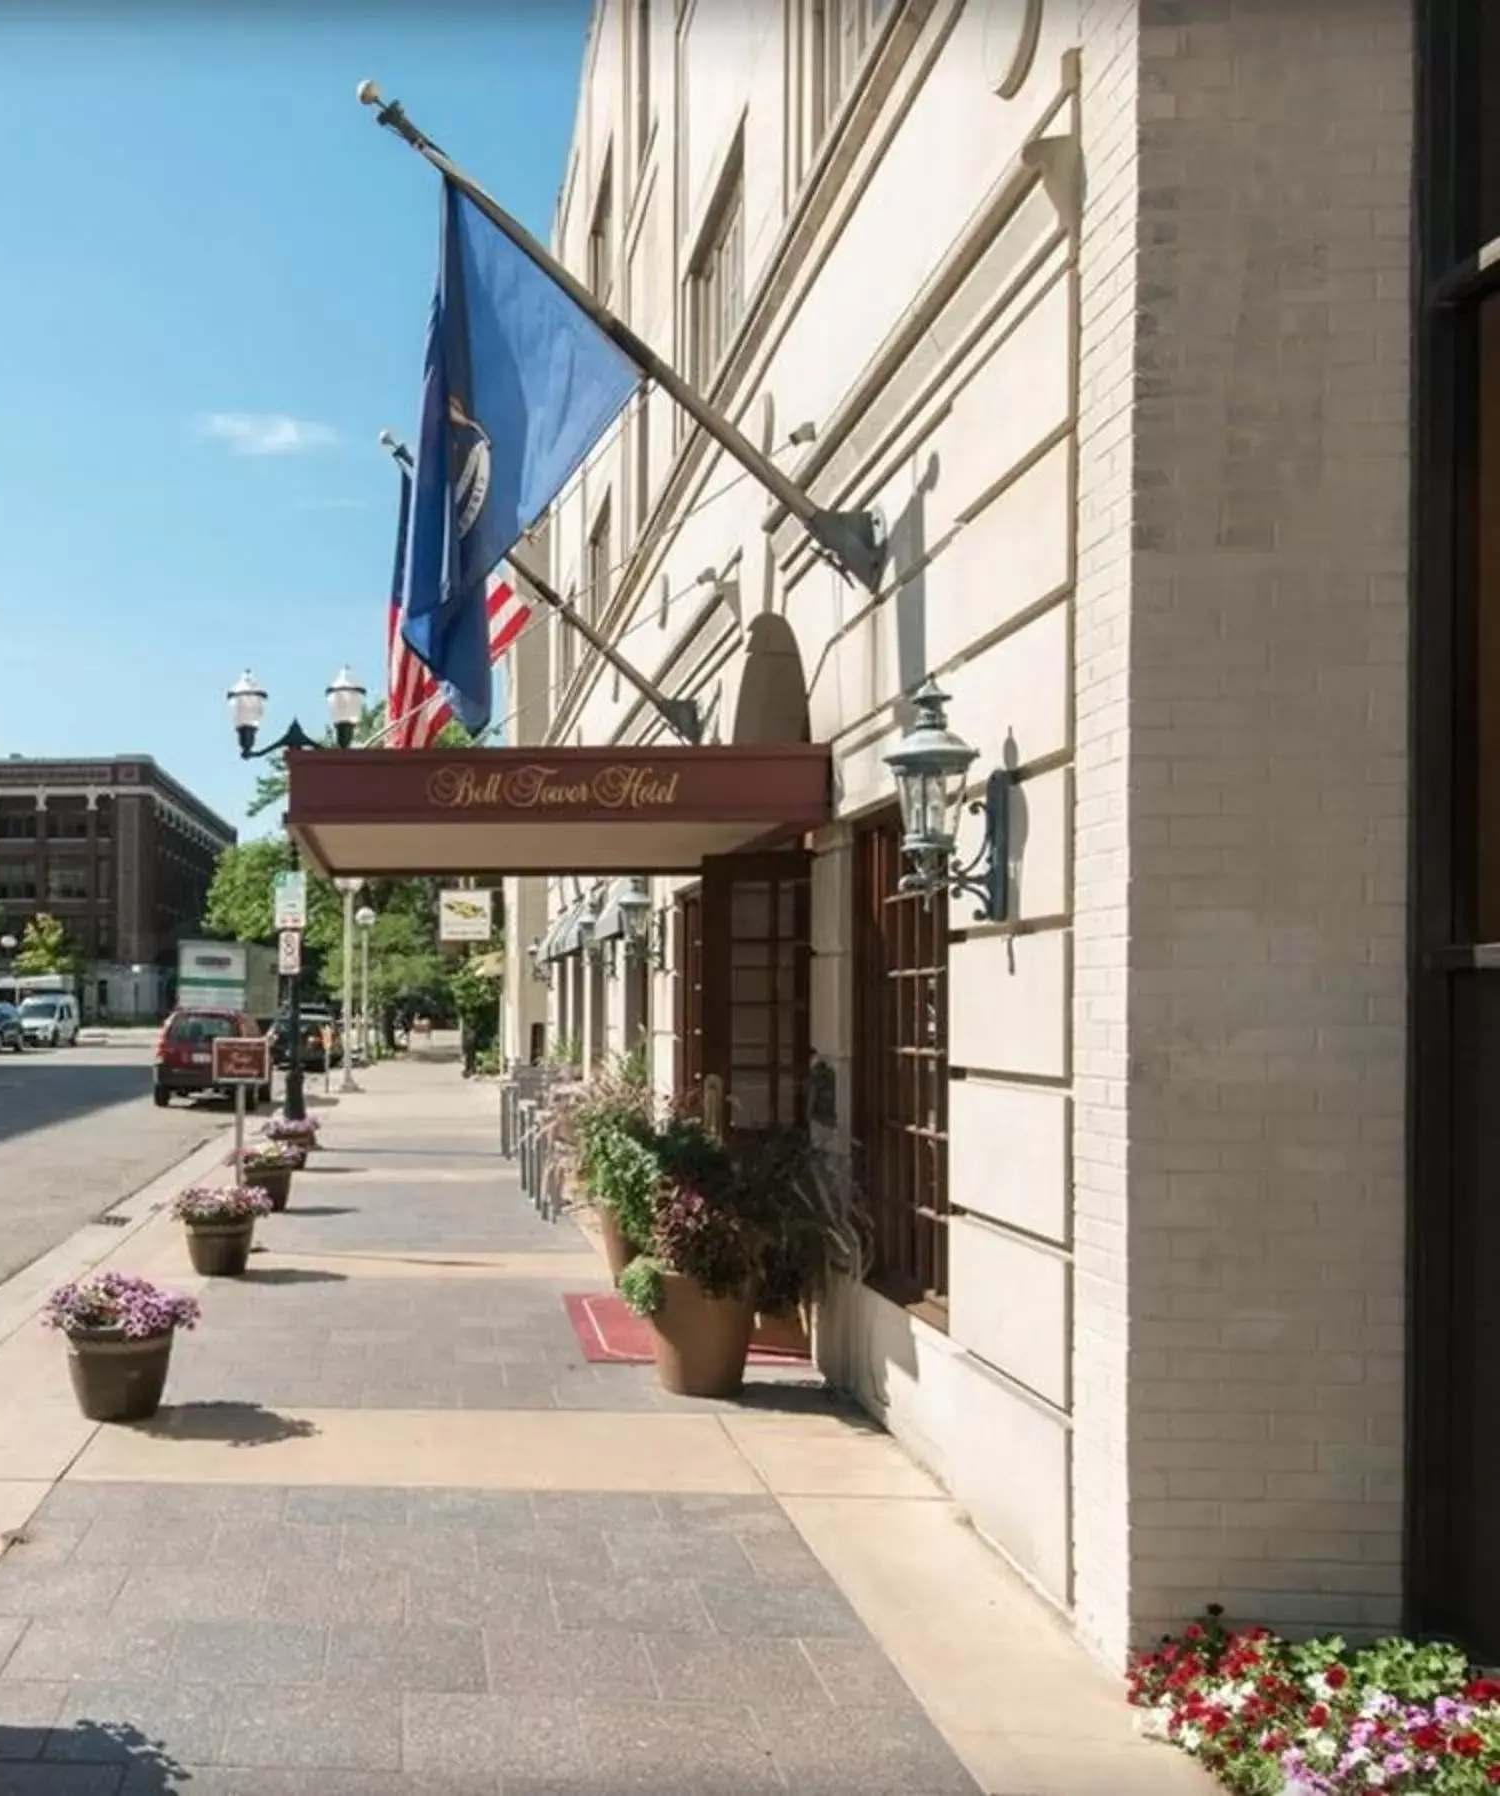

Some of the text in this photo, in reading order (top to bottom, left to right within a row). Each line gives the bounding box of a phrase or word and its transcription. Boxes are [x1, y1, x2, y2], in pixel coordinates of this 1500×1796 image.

[427, 764, 679, 808] Bell Tower Hotel
